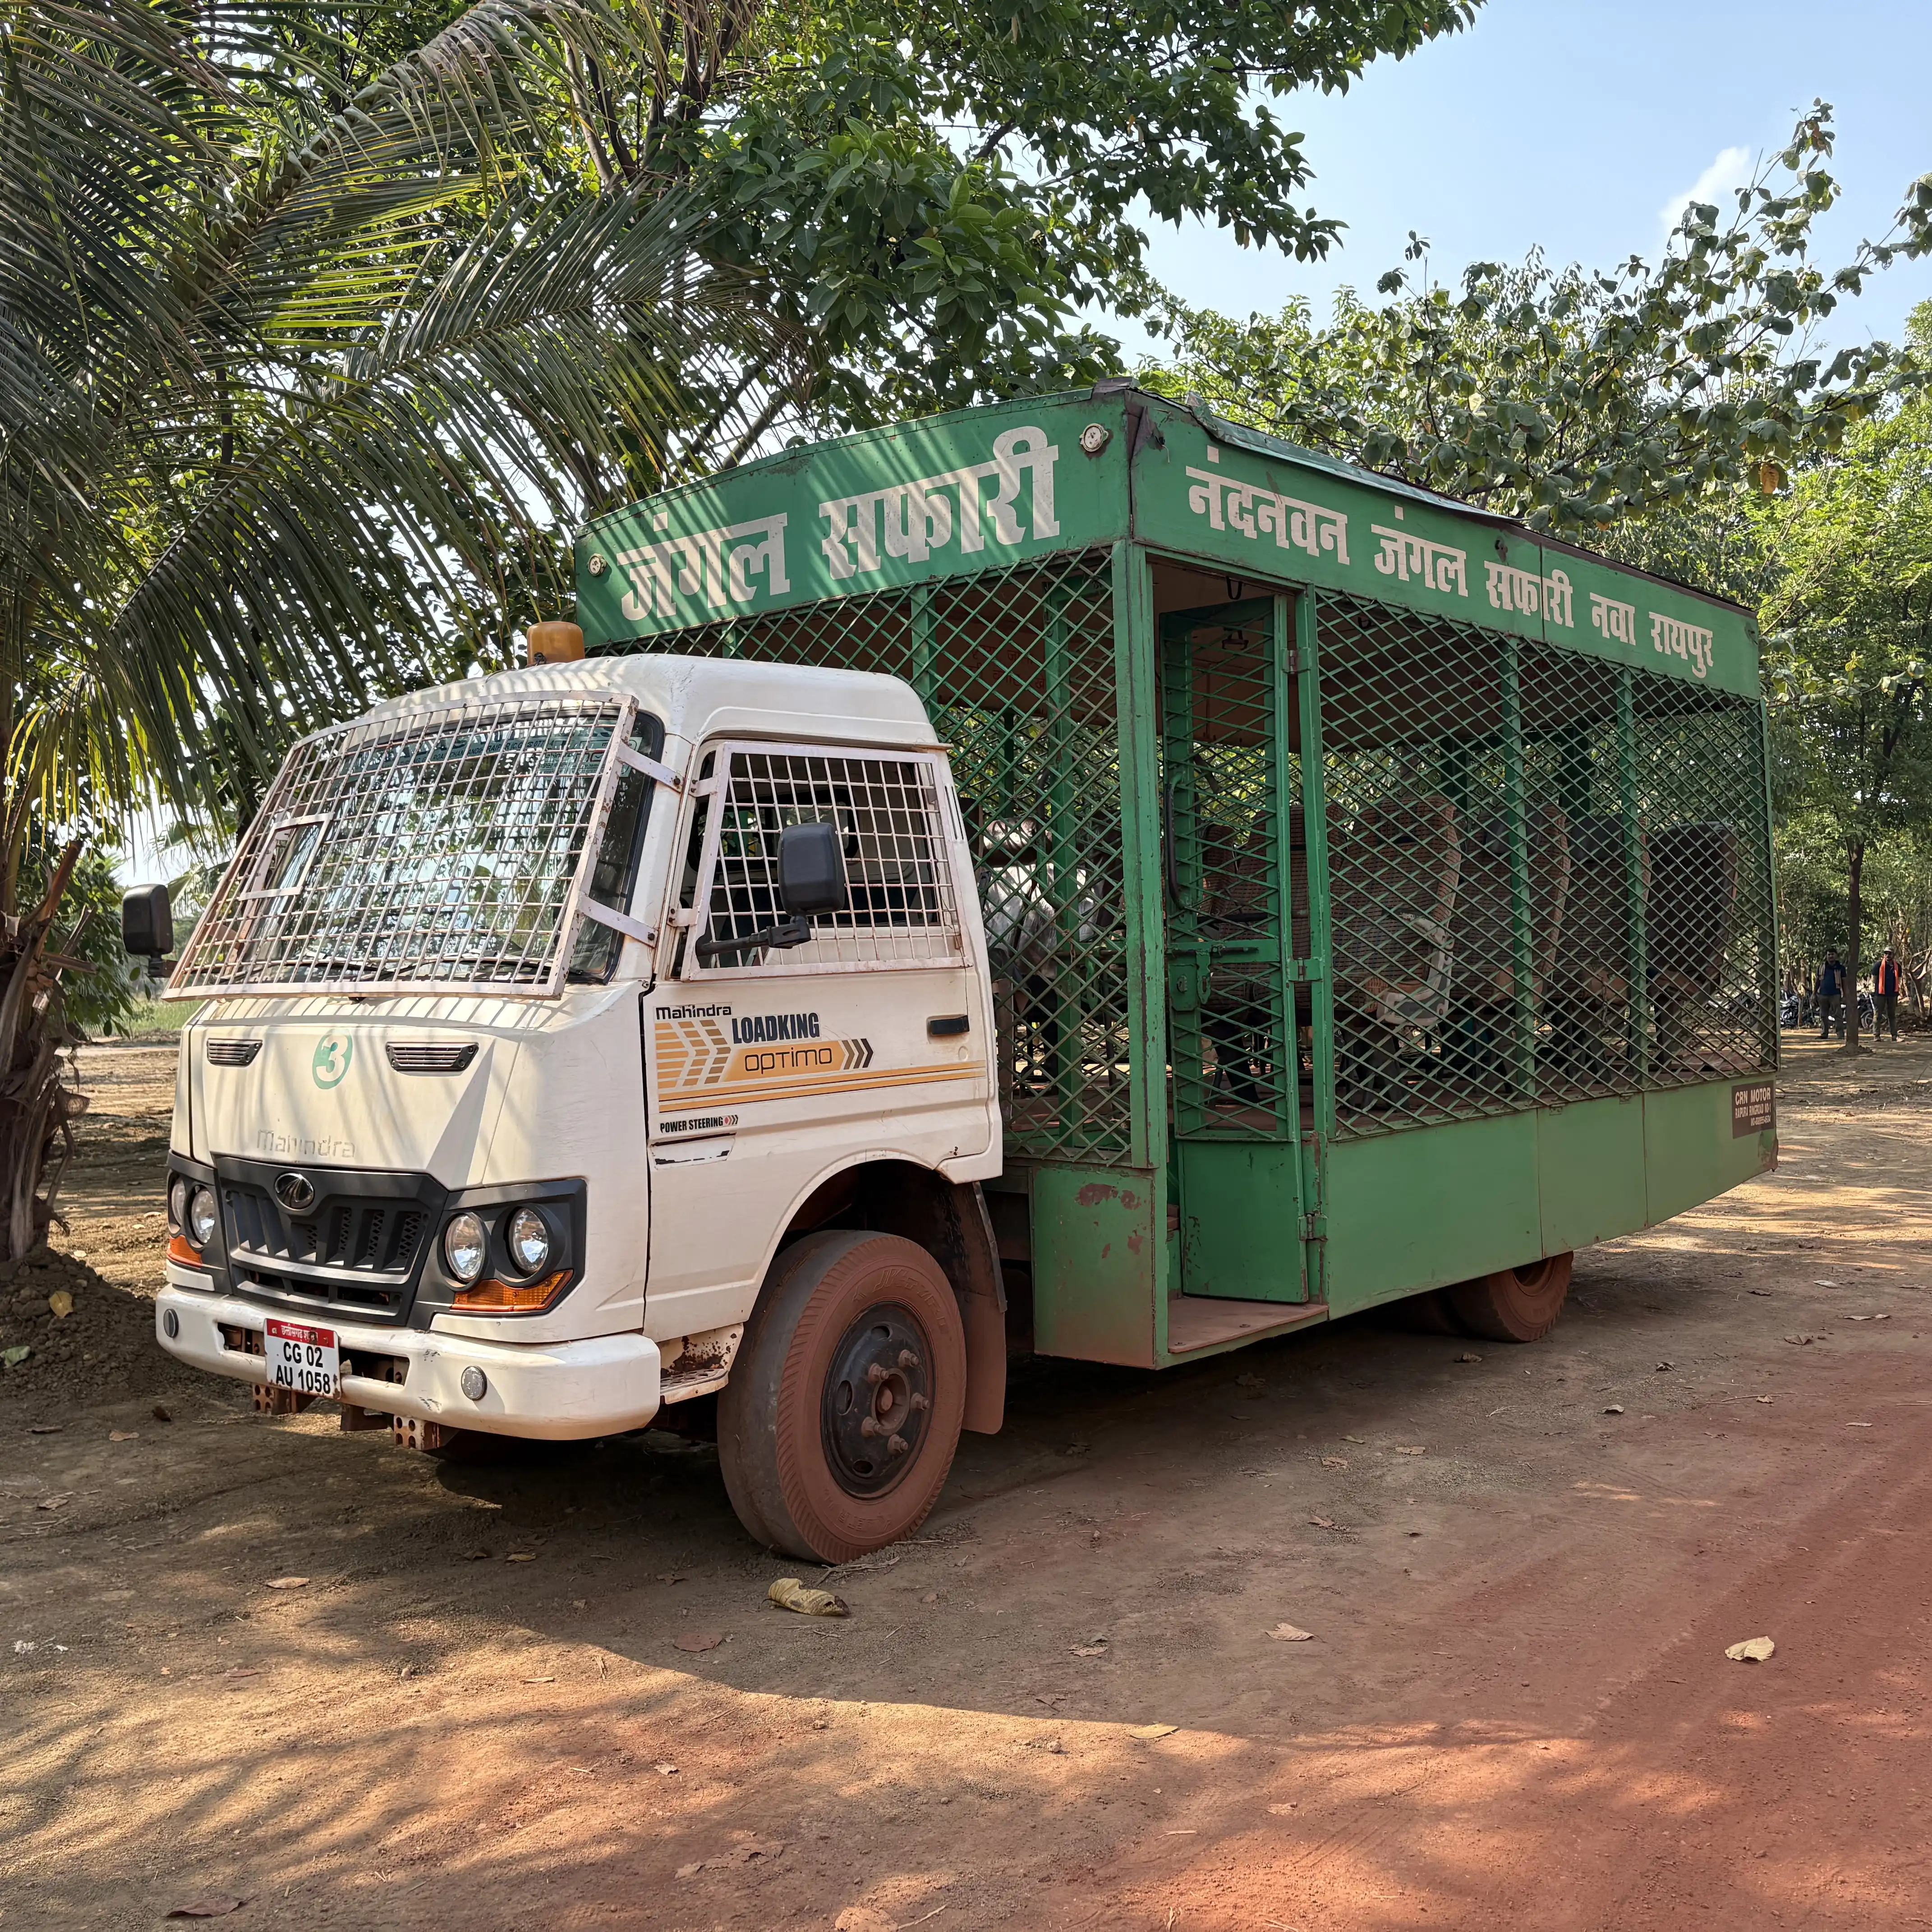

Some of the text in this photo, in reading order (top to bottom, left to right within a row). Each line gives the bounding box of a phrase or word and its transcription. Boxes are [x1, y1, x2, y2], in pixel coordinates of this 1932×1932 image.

[616, 425, 1060, 621] जंगल सफारी
[1186, 445, 1714, 679] नंदनवन जंगल सफारी नवा रायपुर
[732, 1012, 820, 1044] LOADKING
[316, 1032, 347, 1082] 3
[1735, 1087, 1771, 1105] CRN MOTOR
[660, 1117, 723, 1133] POWER STEERING
[283, 1342, 323, 1368] CG 02
[276, 1365, 331, 1394] AU 1058
